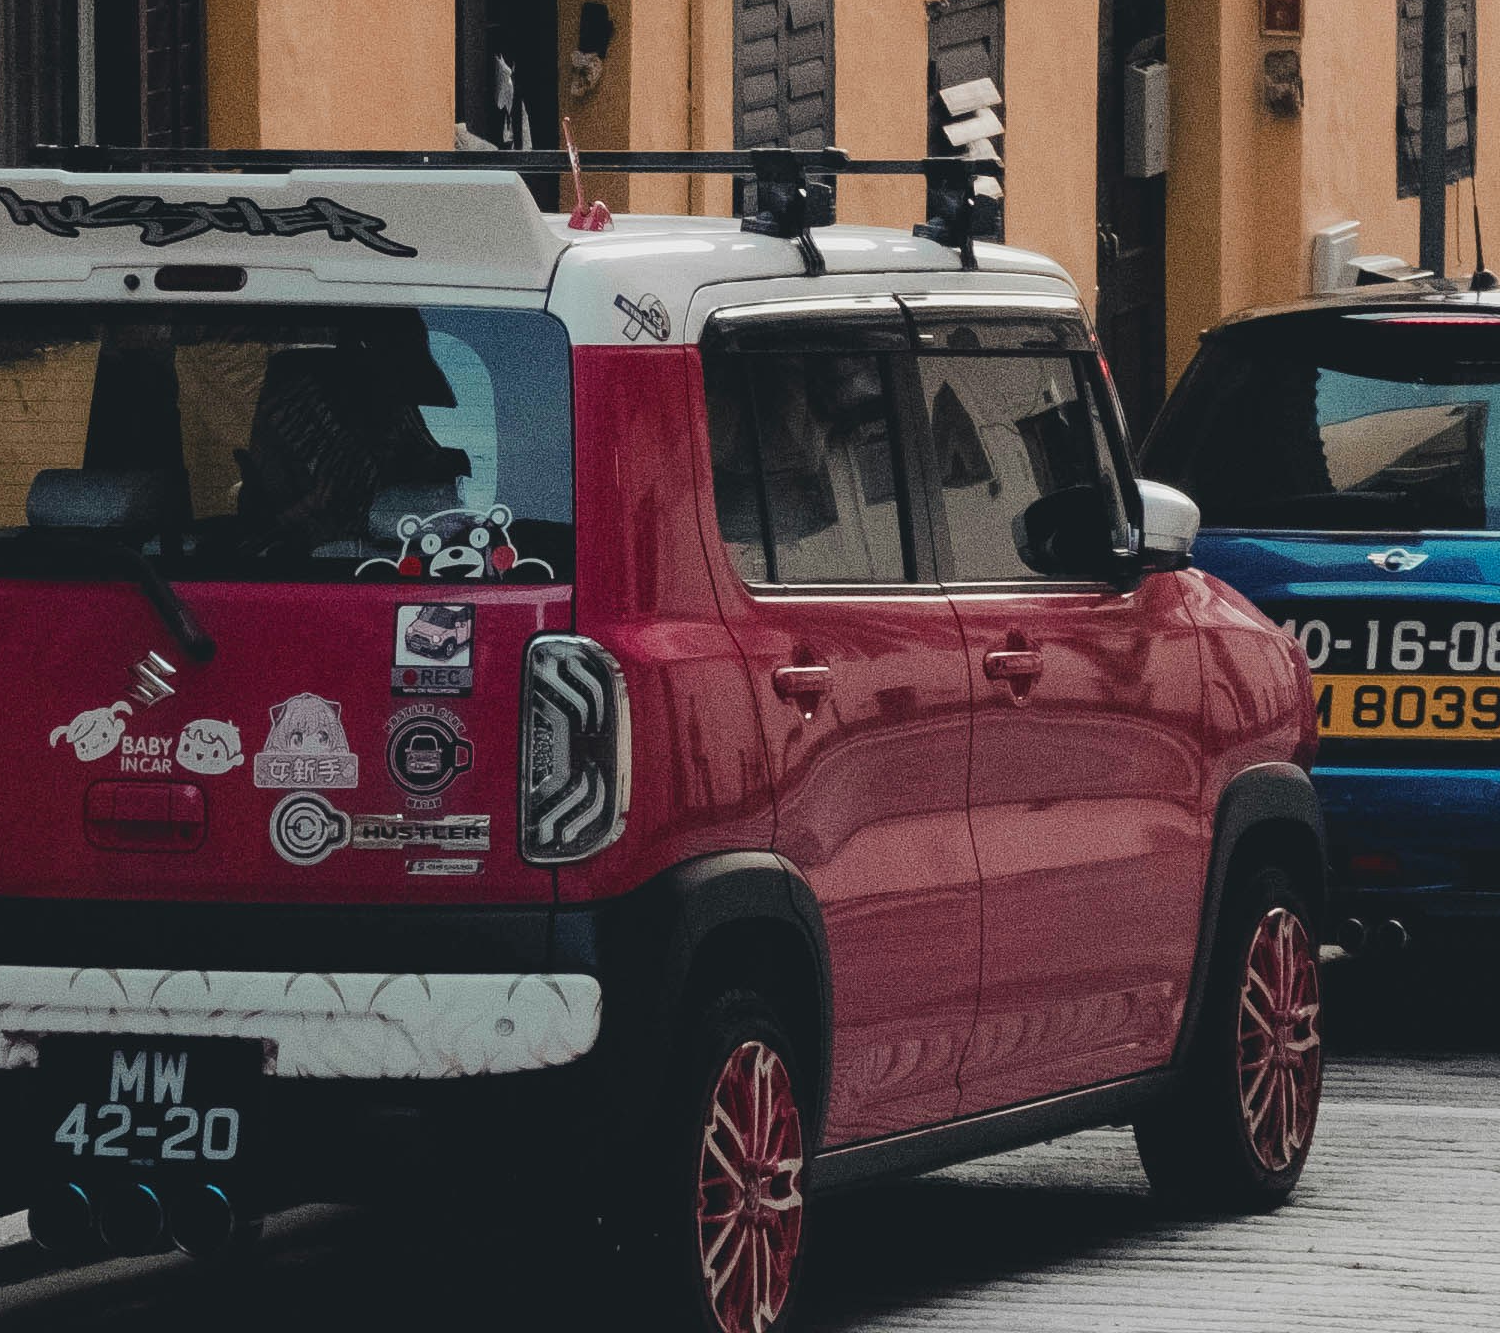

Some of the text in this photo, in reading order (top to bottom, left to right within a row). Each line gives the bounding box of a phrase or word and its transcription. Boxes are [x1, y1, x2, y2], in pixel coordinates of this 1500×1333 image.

[420, 669, 461, 686] REC
[121, 735, 174, 757] BABY
[120, 755, 173, 775] IN CAR
[268, 757, 341, 783] 女新手
[362, 825, 481, 840] HUSTLER
[109, 1049, 188, 1104] MW
[54, 1102, 240, 1161] 42-20
